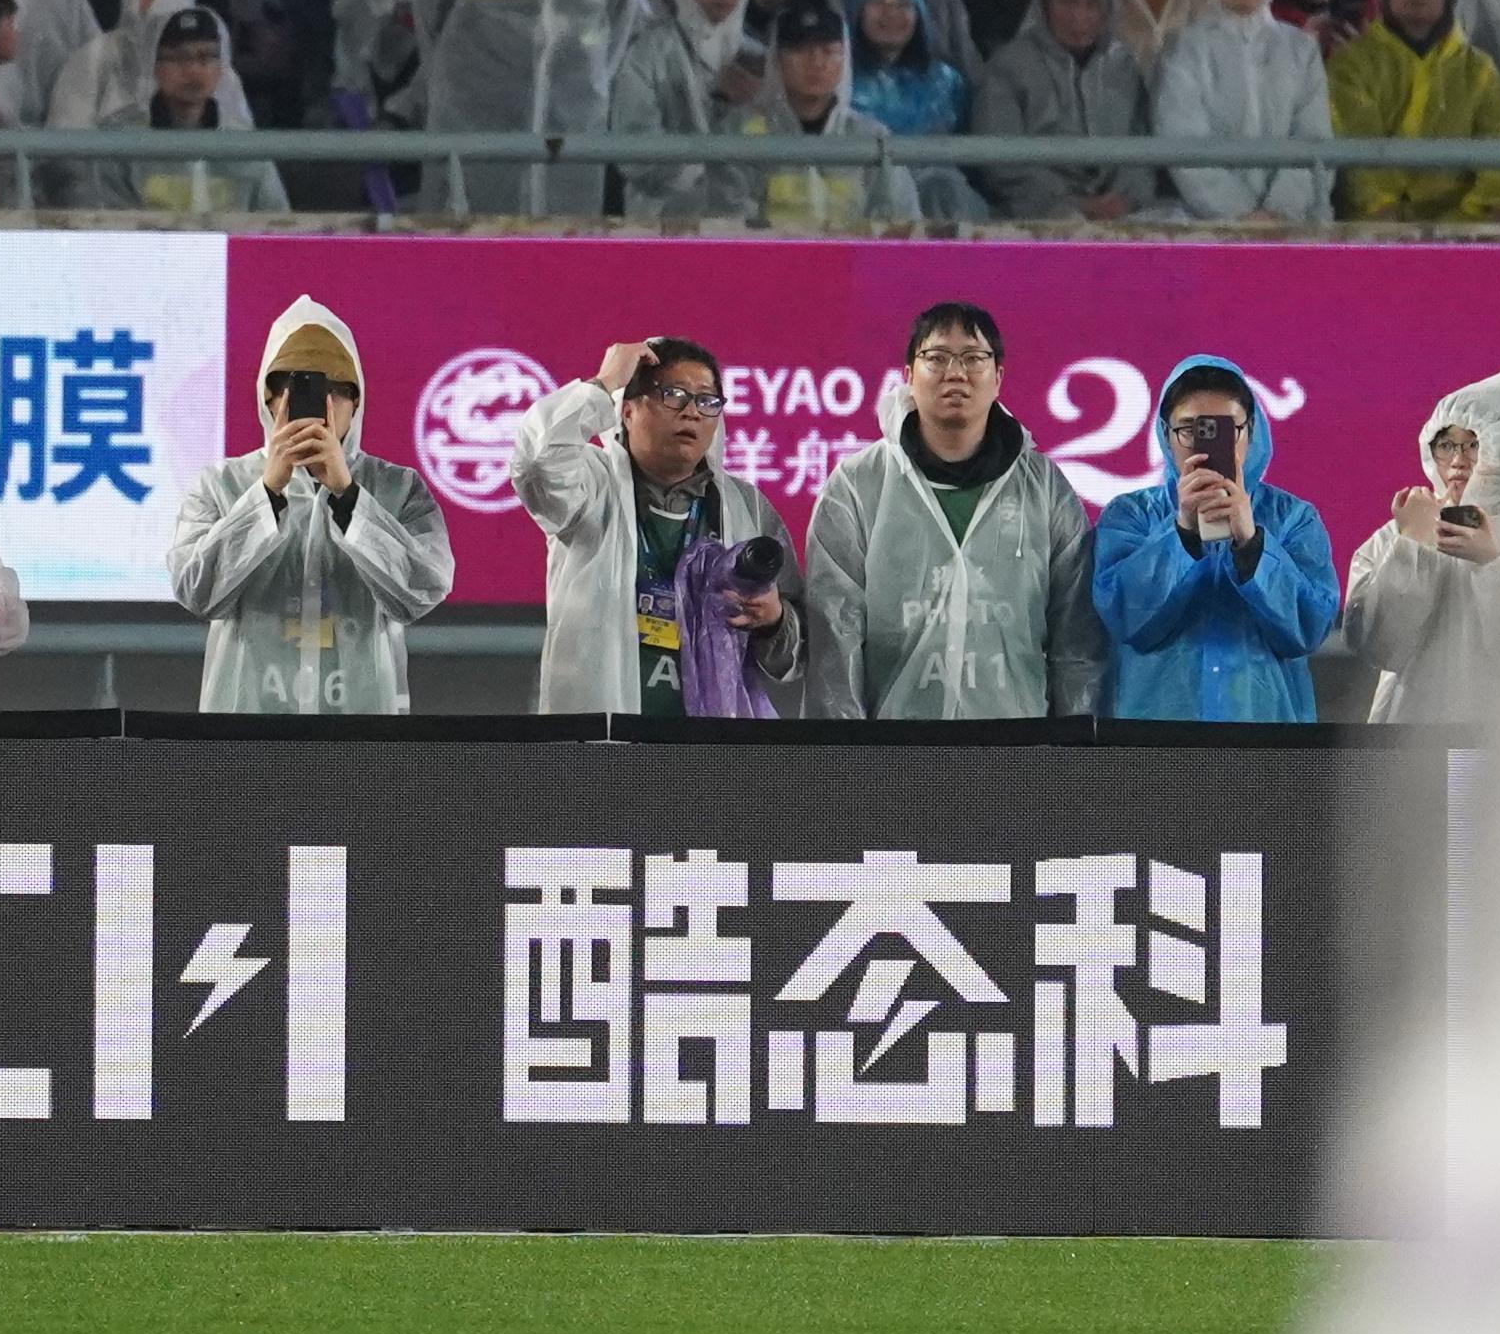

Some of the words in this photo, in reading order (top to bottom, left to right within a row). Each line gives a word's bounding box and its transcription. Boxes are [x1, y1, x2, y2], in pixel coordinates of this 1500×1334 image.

[723, 367, 865, 416] EYAO
[503, 845, 1288, 1129] 酷态科
